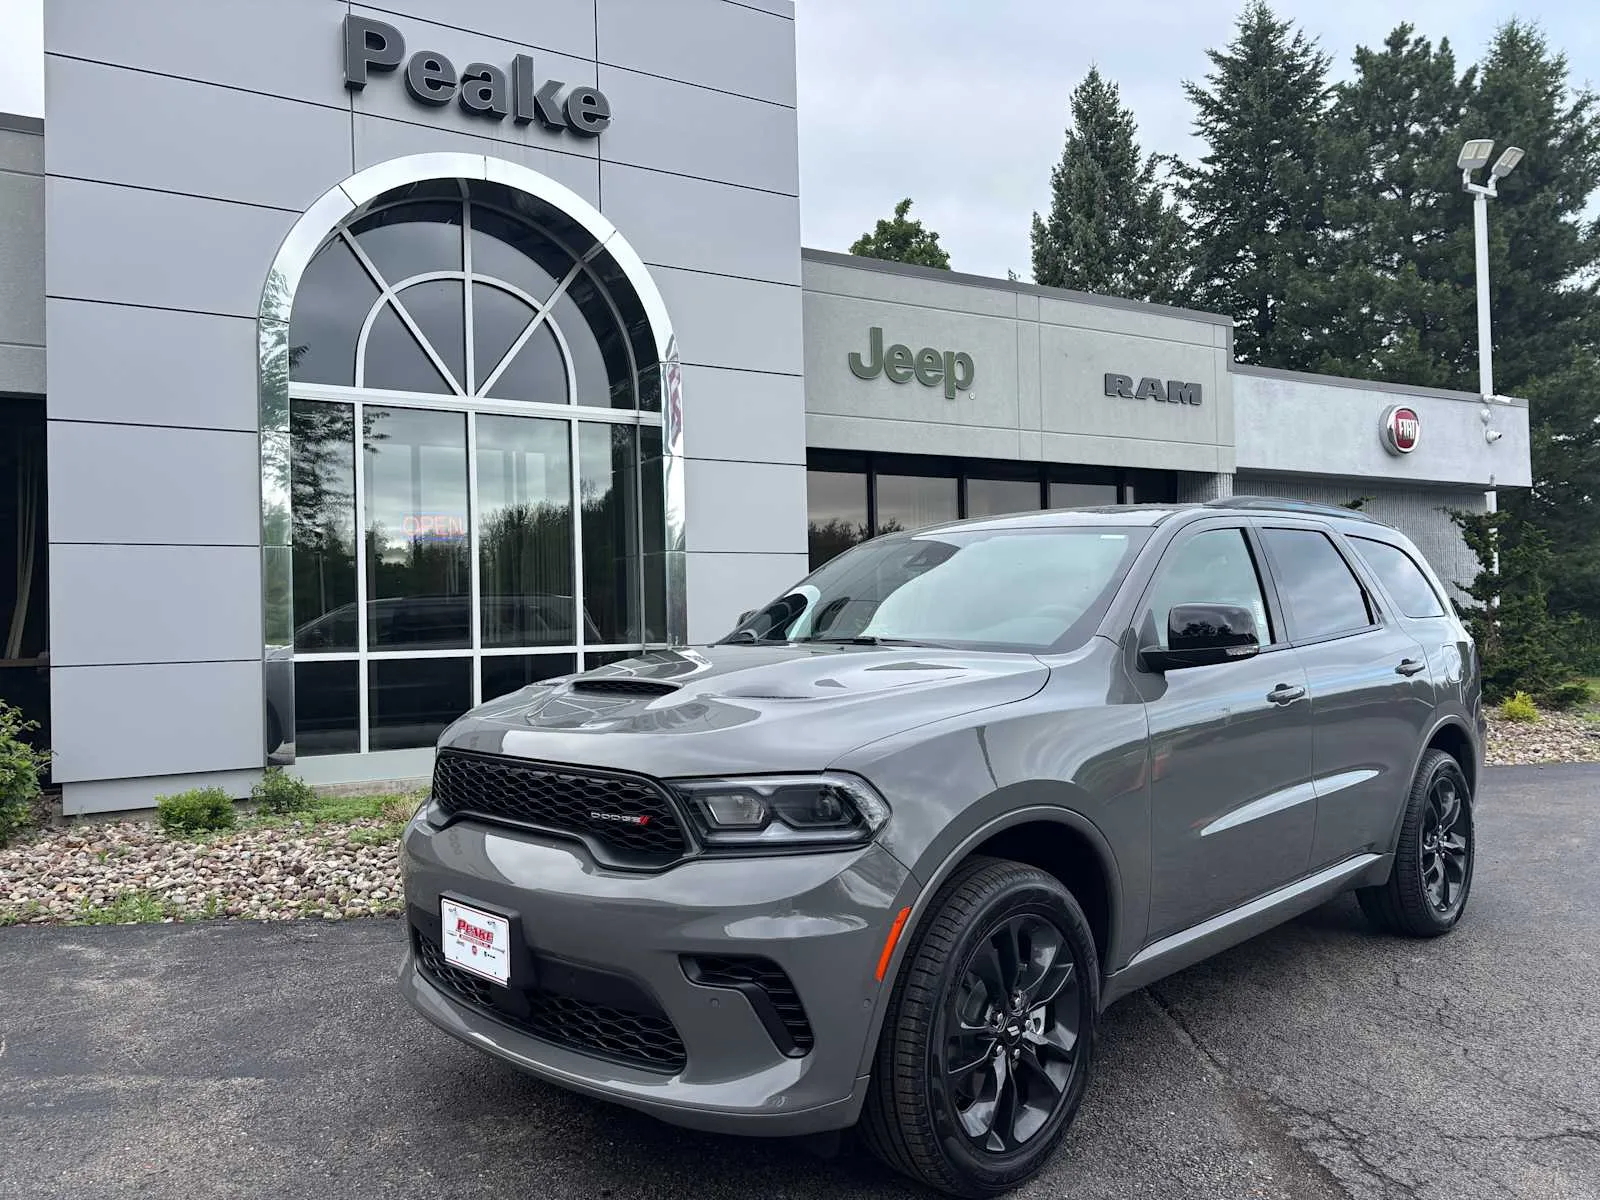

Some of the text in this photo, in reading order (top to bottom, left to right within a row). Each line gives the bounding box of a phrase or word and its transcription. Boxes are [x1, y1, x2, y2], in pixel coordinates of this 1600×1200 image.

[344, 13, 611, 138] Peake
[848, 326, 975, 400] Jeep
[1104, 372, 1202, 405] RAM
[402, 514, 465, 537] OPEN
[591, 812, 641, 823] DODGE
[457, 918, 493, 945] PEAKE
